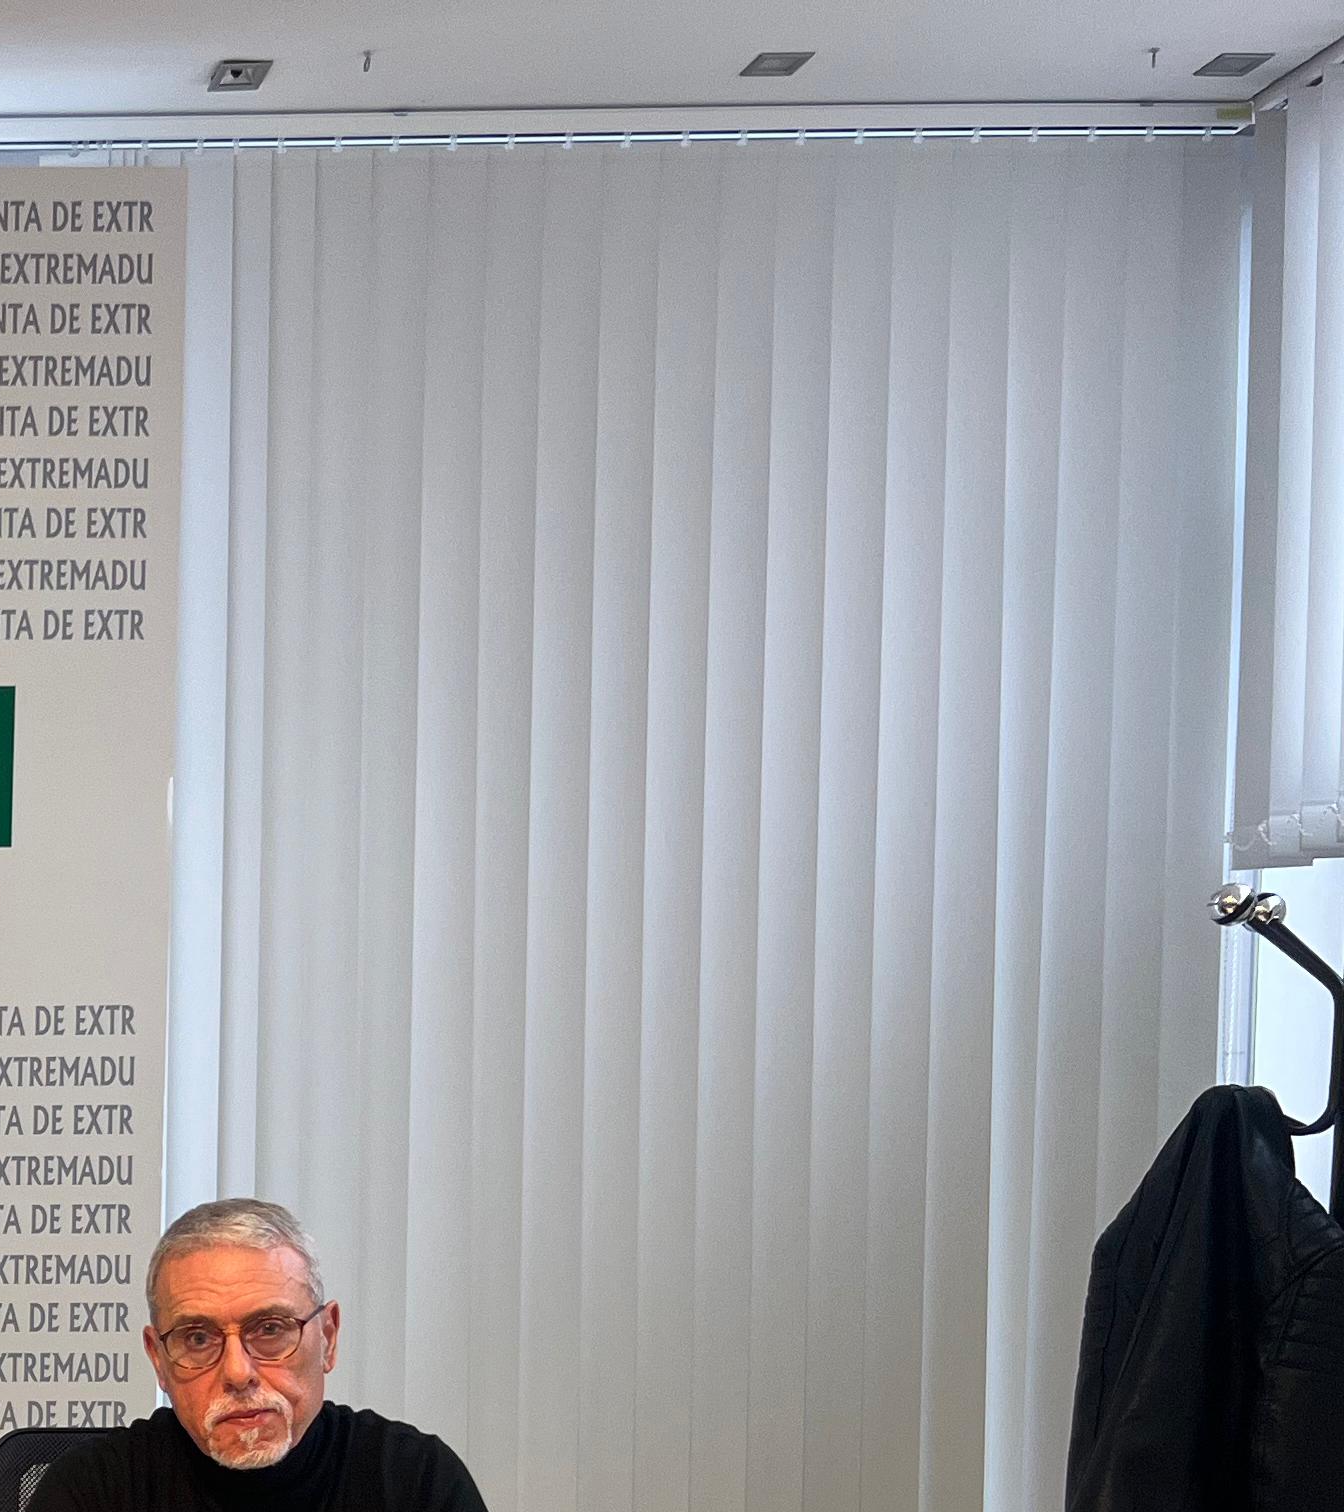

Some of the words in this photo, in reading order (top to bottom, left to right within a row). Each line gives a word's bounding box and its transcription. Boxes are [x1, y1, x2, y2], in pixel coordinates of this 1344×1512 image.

[51, 199, 84, 233] DE
[92, 199, 155, 234] EXTR
[0, 251, 154, 286] EXTREMADU
[49, 302, 82, 335] DE
[90, 302, 153, 336] EXTR
[34, 1004, 67, 1037] DE
[74, 1003, 137, 1037] EXTR
[30, 1203, 63, 1235] DE
[70, 1202, 133, 1235] EXTR
